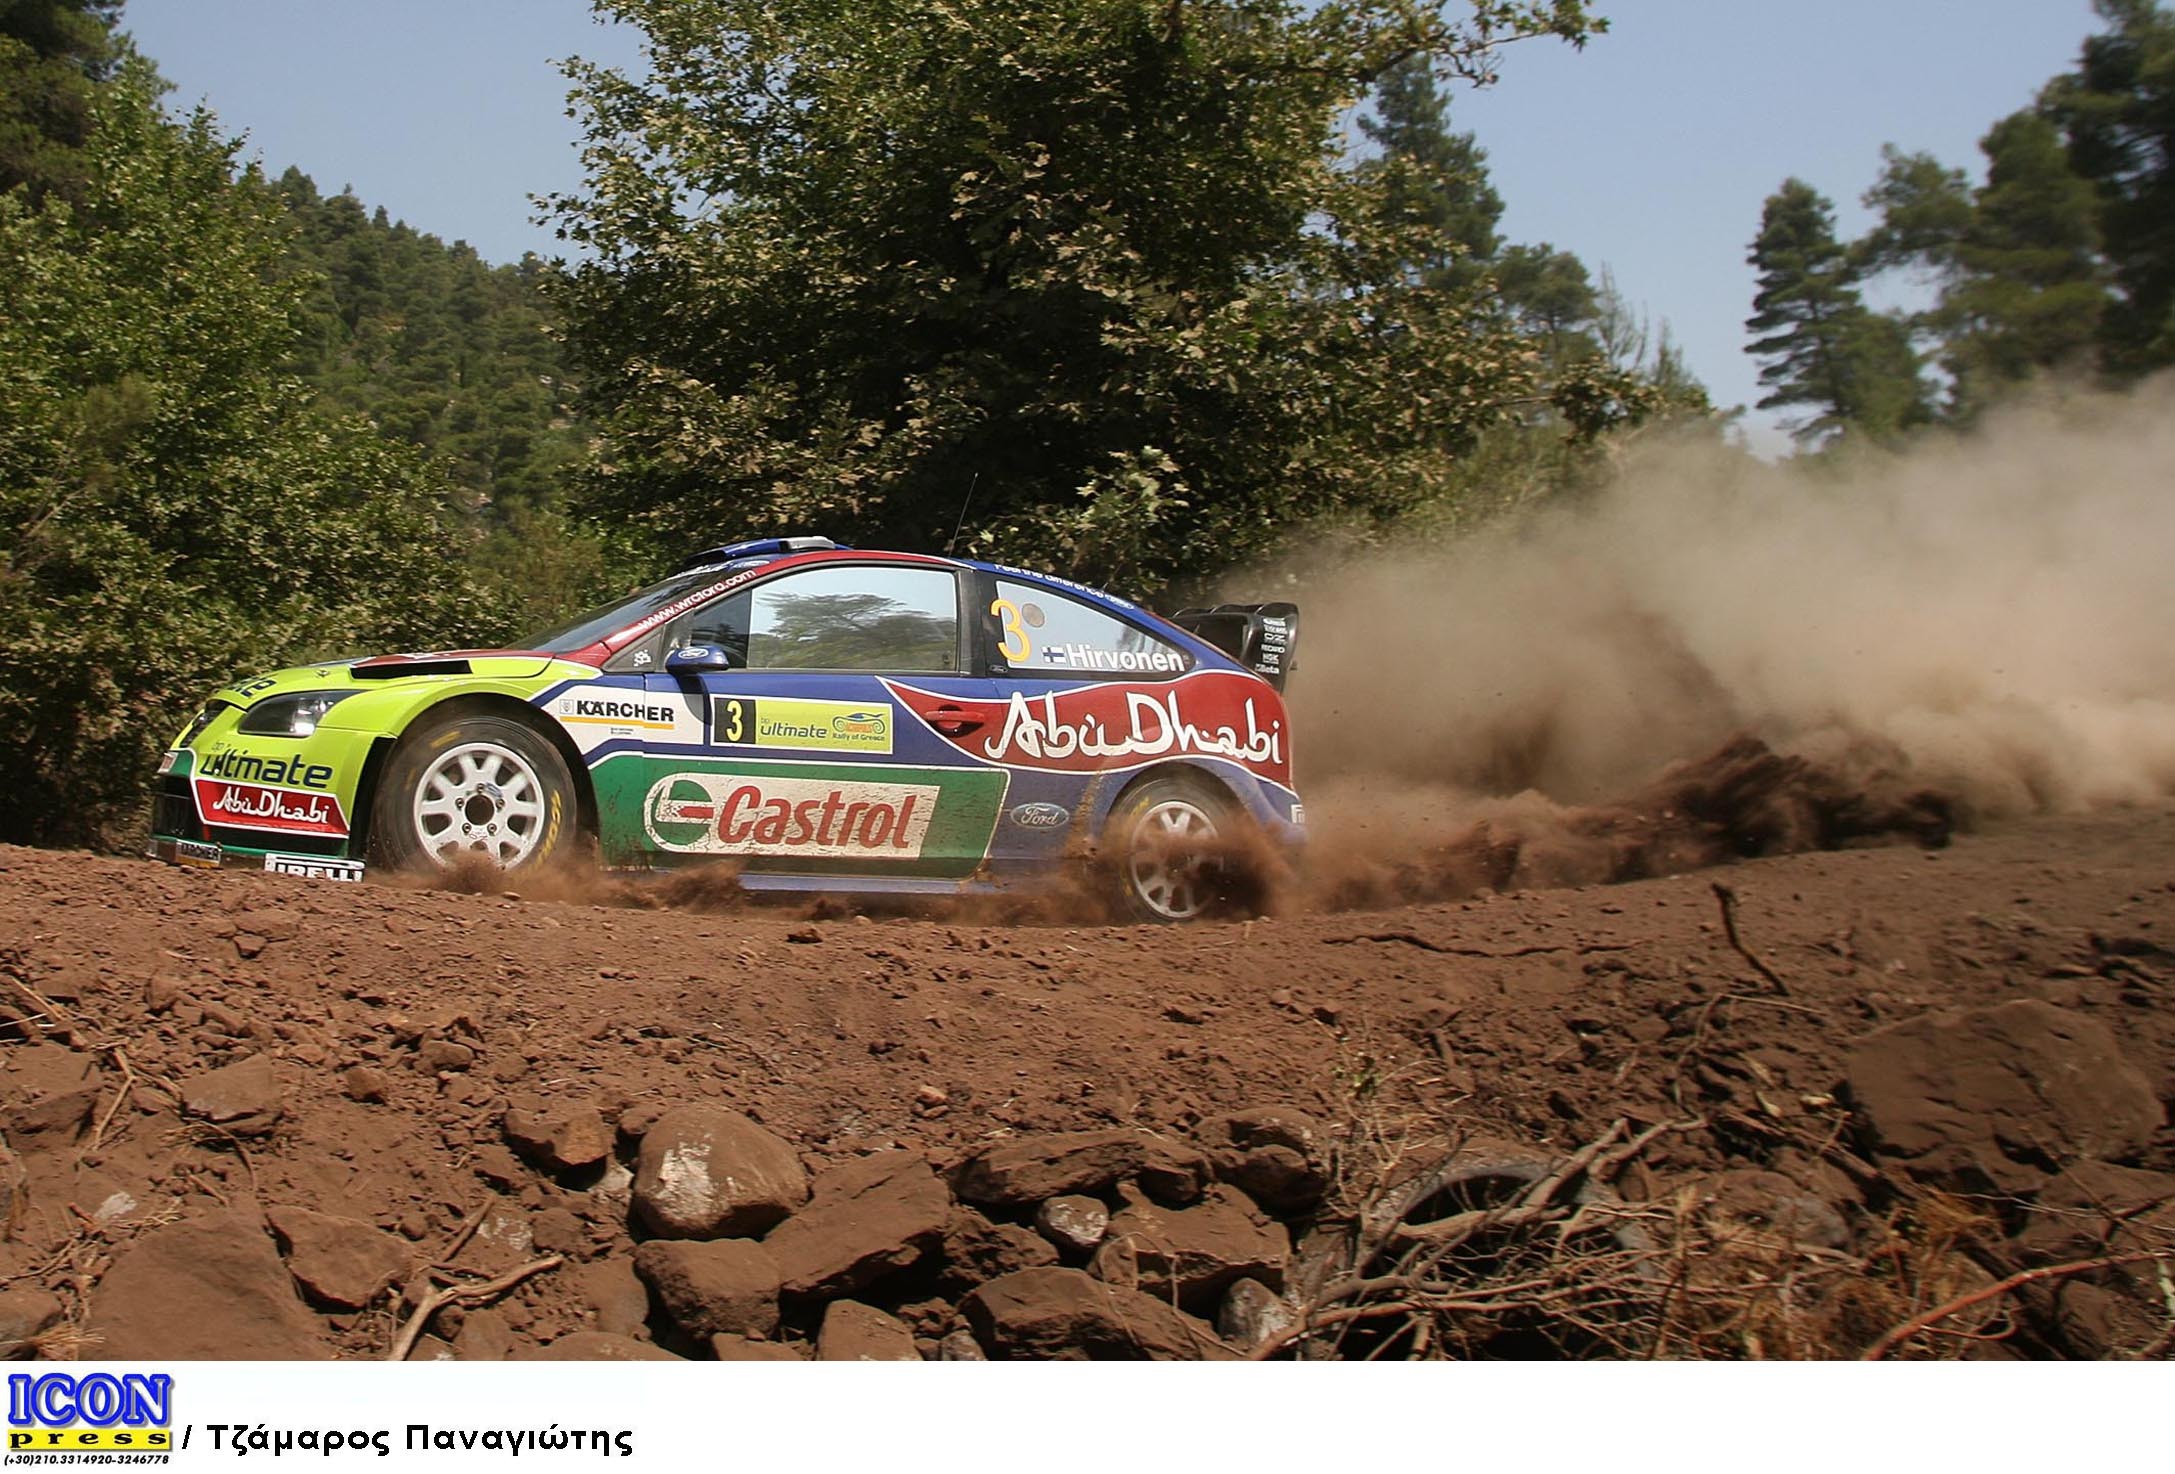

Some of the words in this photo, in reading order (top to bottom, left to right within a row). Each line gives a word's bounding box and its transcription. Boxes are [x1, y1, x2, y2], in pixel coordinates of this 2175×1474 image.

[991, 599, 1031, 662] 3
[1066, 642, 1185, 672] Hirvonen
[577, 700, 674, 722] KÄRCHER
[726, 700, 743, 742] 3
[760, 722, 827, 738] ultimate
[984, 690, 1134, 759] Abu
[1126, 689, 1283, 764] Dhabi
[200, 748, 332, 789] ultimate
[212, 786, 261, 815] Abu
[258, 789, 329, 824] Dhabi
[716, 785, 918, 849] Castrol
[1020, 808, 1058, 827] Ford
